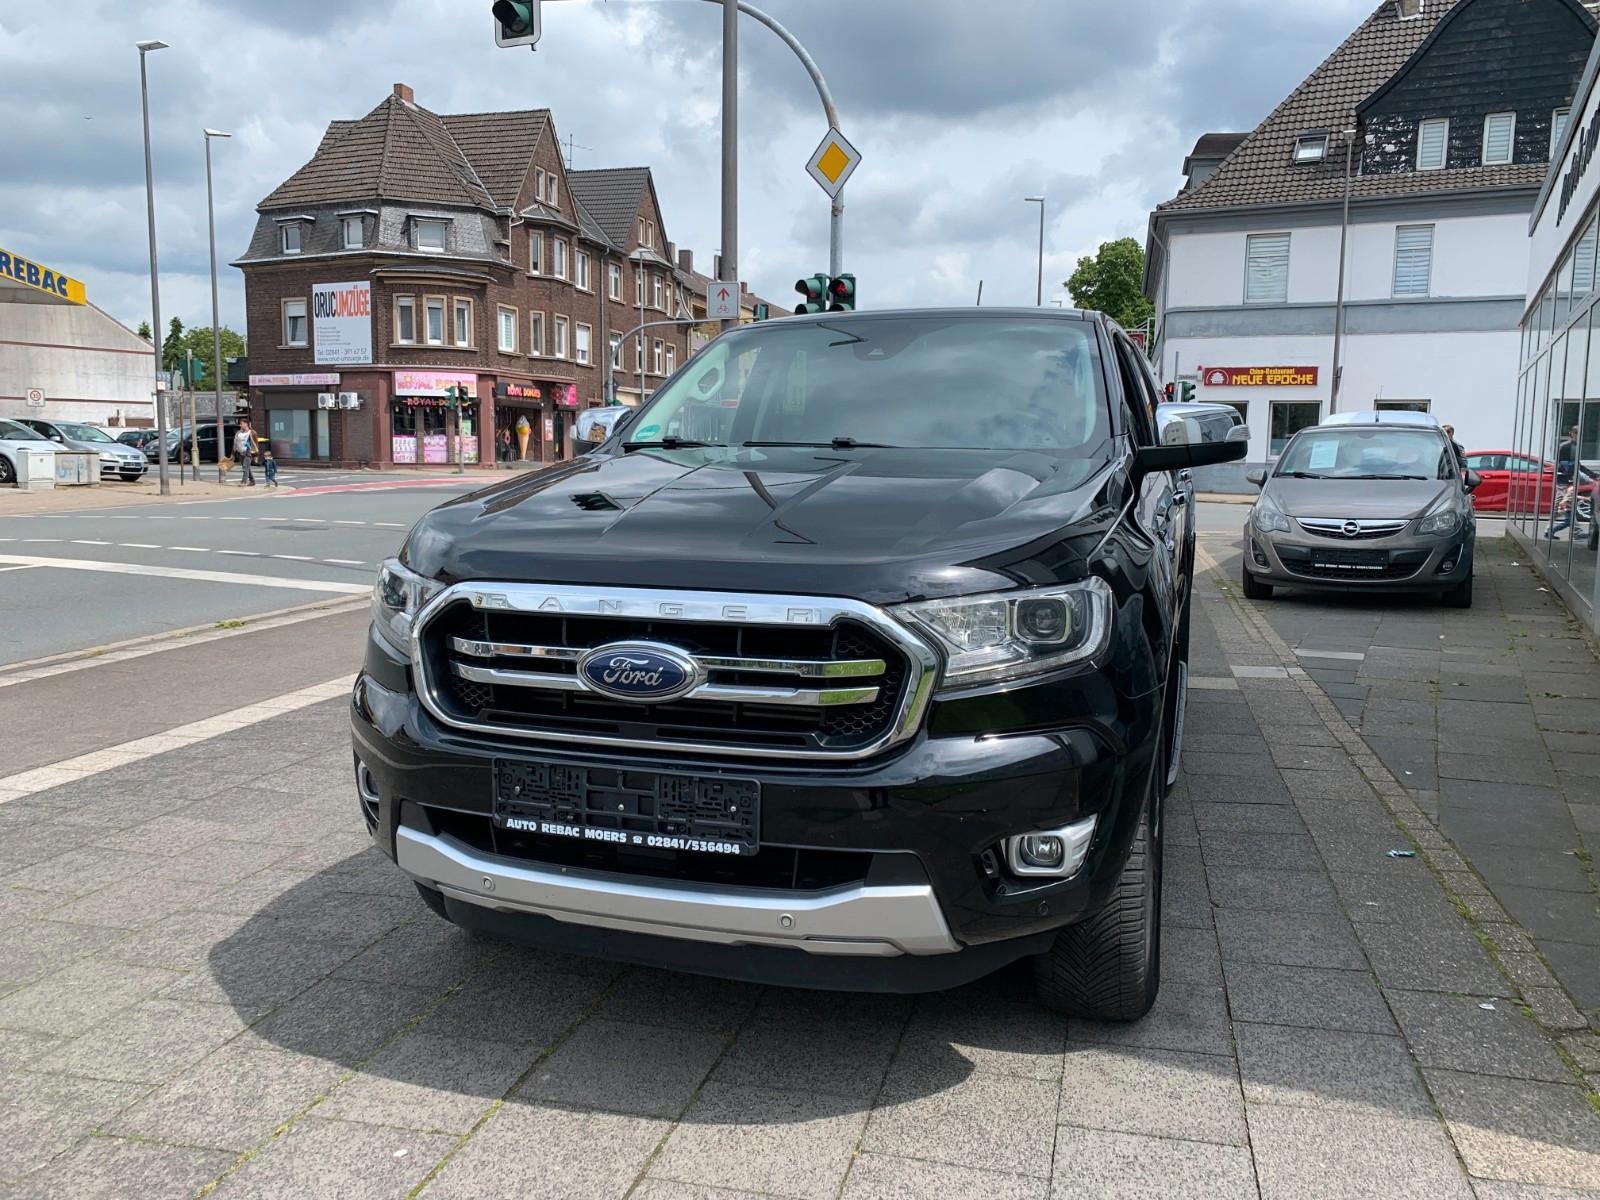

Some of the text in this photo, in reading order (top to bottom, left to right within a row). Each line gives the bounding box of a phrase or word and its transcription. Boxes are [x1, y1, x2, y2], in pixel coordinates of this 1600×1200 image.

[0, 250, 69, 297] REBAC
[1232, 374, 1314, 385] NEUE EPOCHE
[1249, 367, 1295, 375] China-Restaurant
[485, 592, 816, 625] RANGER
[603, 656, 664, 687] Ford
[506, 818, 741, 855] AUTO REBAC MOERS 02841/536494
